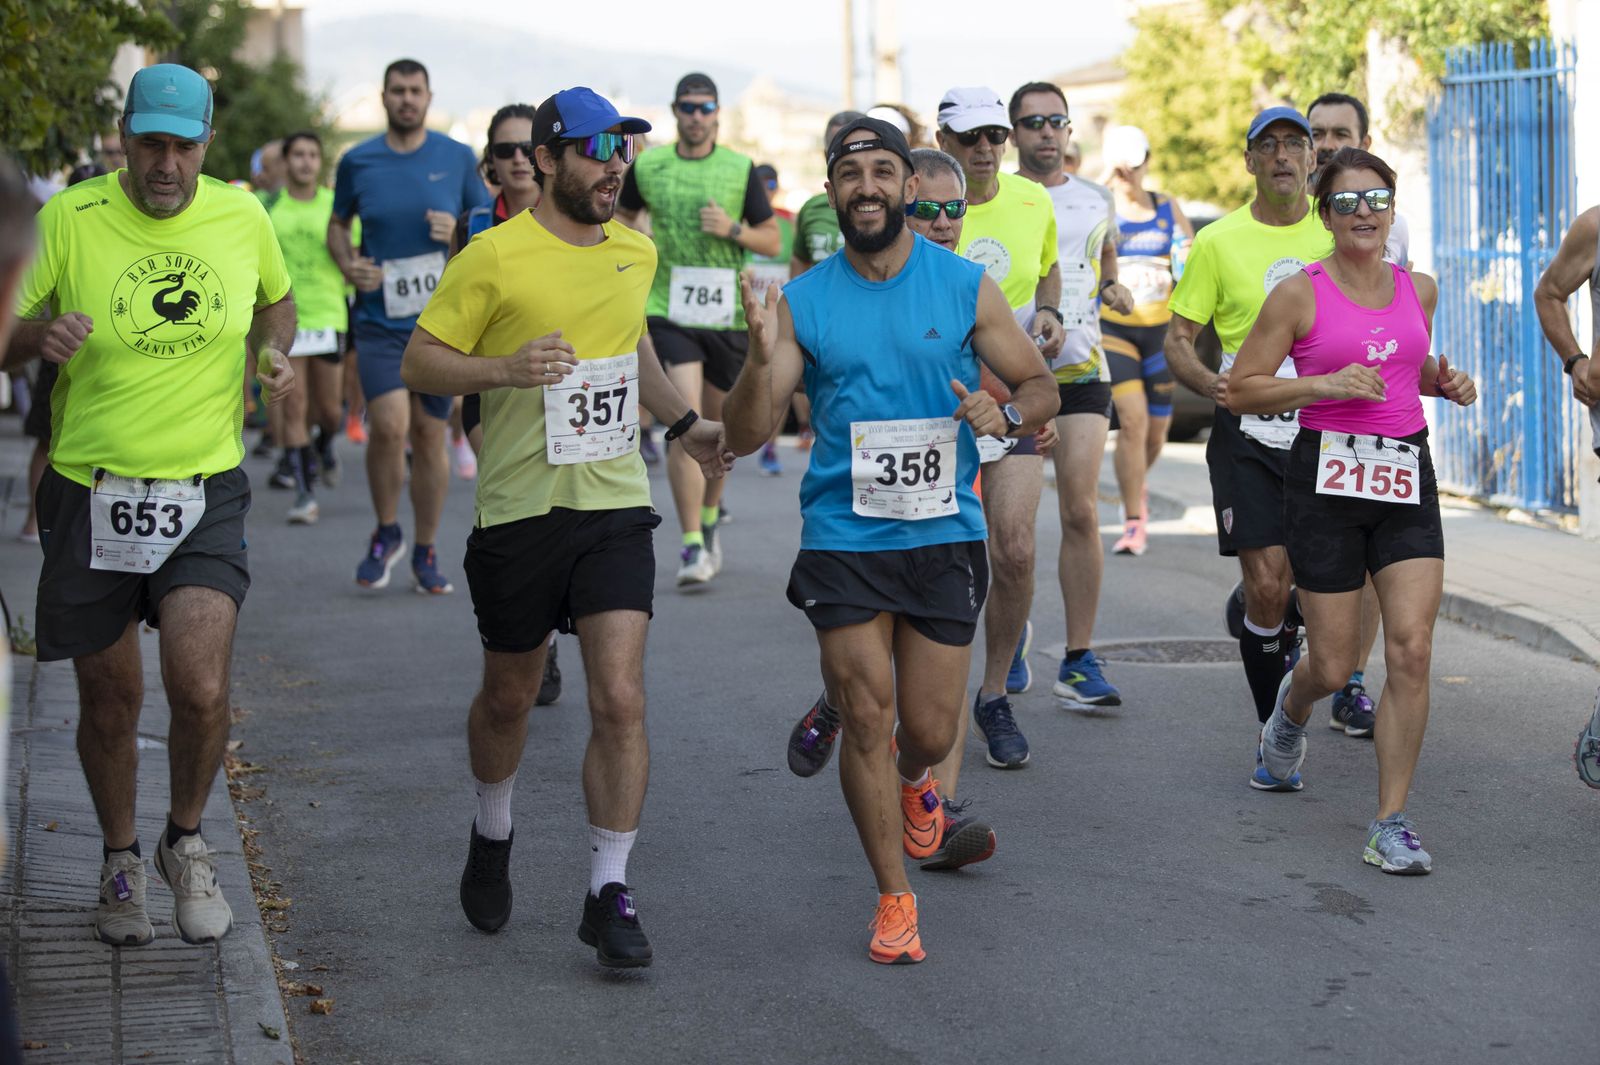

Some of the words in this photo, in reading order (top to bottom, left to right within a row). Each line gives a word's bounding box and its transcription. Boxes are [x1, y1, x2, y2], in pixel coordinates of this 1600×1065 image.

[127, 259, 157, 283] BAR
[165, 255, 209, 281] SORIA
[396, 274, 437, 296] 810
[682, 285, 723, 305] 784
[134, 337, 175, 355] RANIN
[182, 334, 206, 352] TIM
[567, 386, 628, 428] 357
[875, 448, 941, 487] 358
[1323, 459, 1413, 499] 2155
[110, 500, 183, 539] 653
